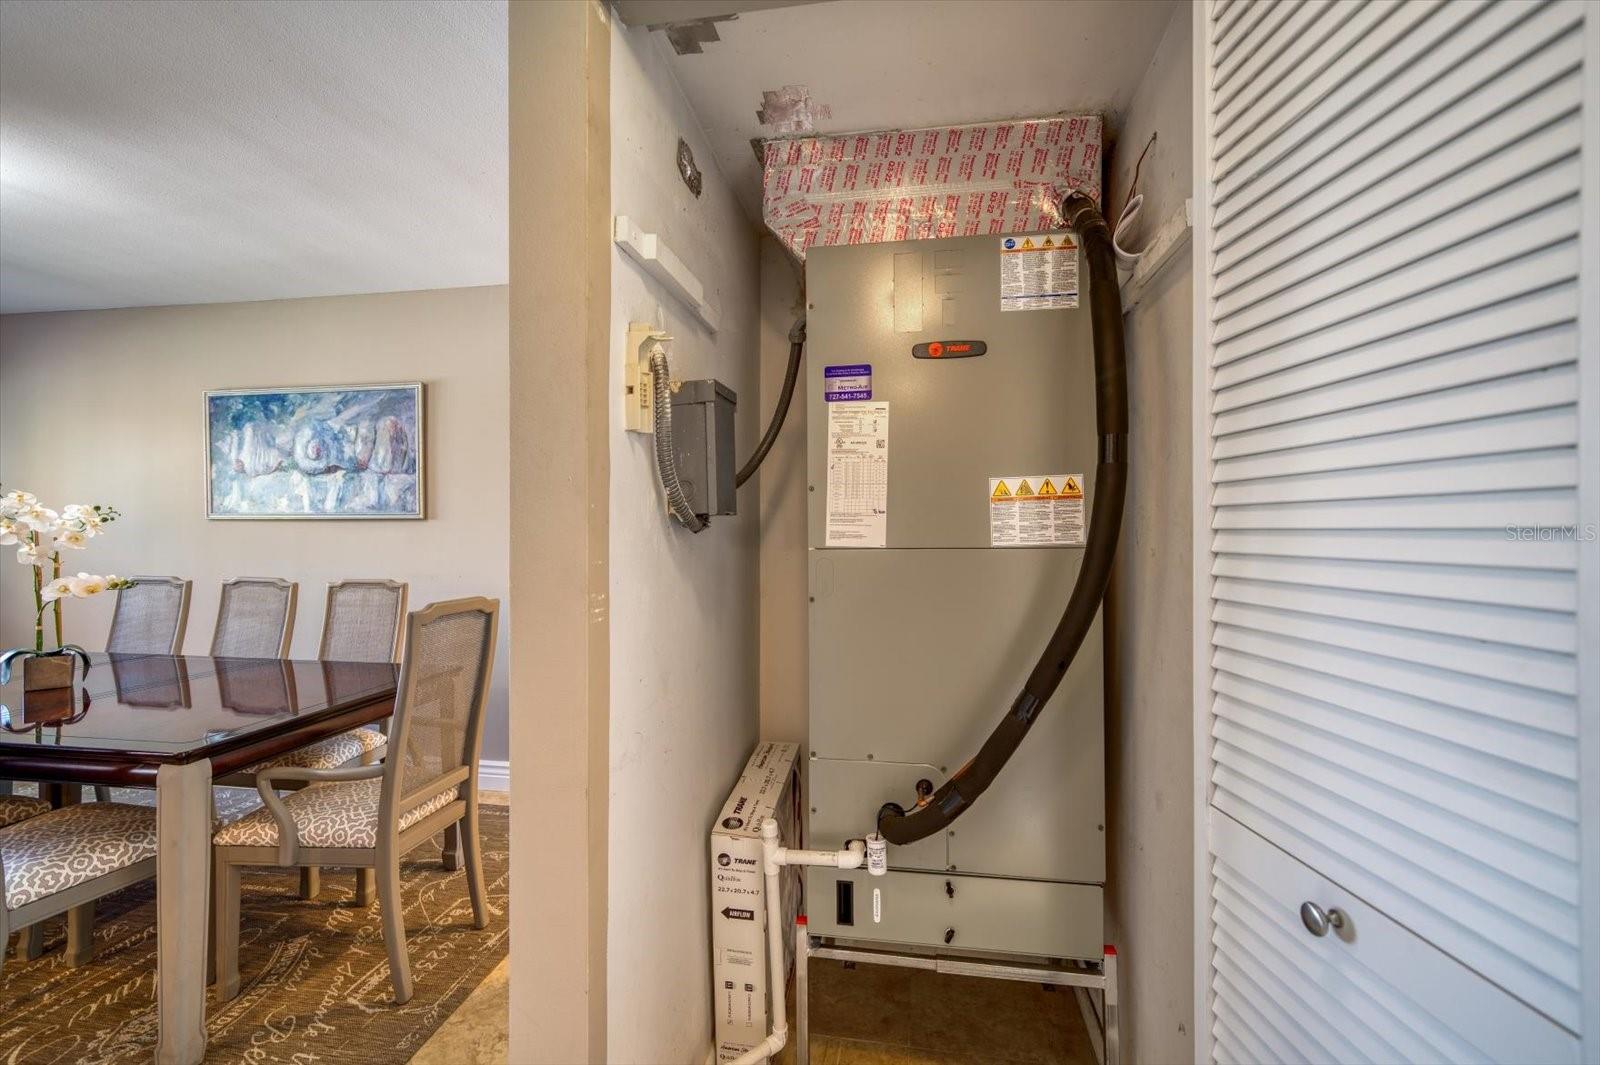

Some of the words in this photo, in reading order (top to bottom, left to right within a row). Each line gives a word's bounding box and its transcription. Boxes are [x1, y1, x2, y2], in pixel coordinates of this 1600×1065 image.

[945, 344, 971, 353] TRANE
[734, 797, 747, 815] TRANE
[729, 909, 751, 918] AIRFLOW
